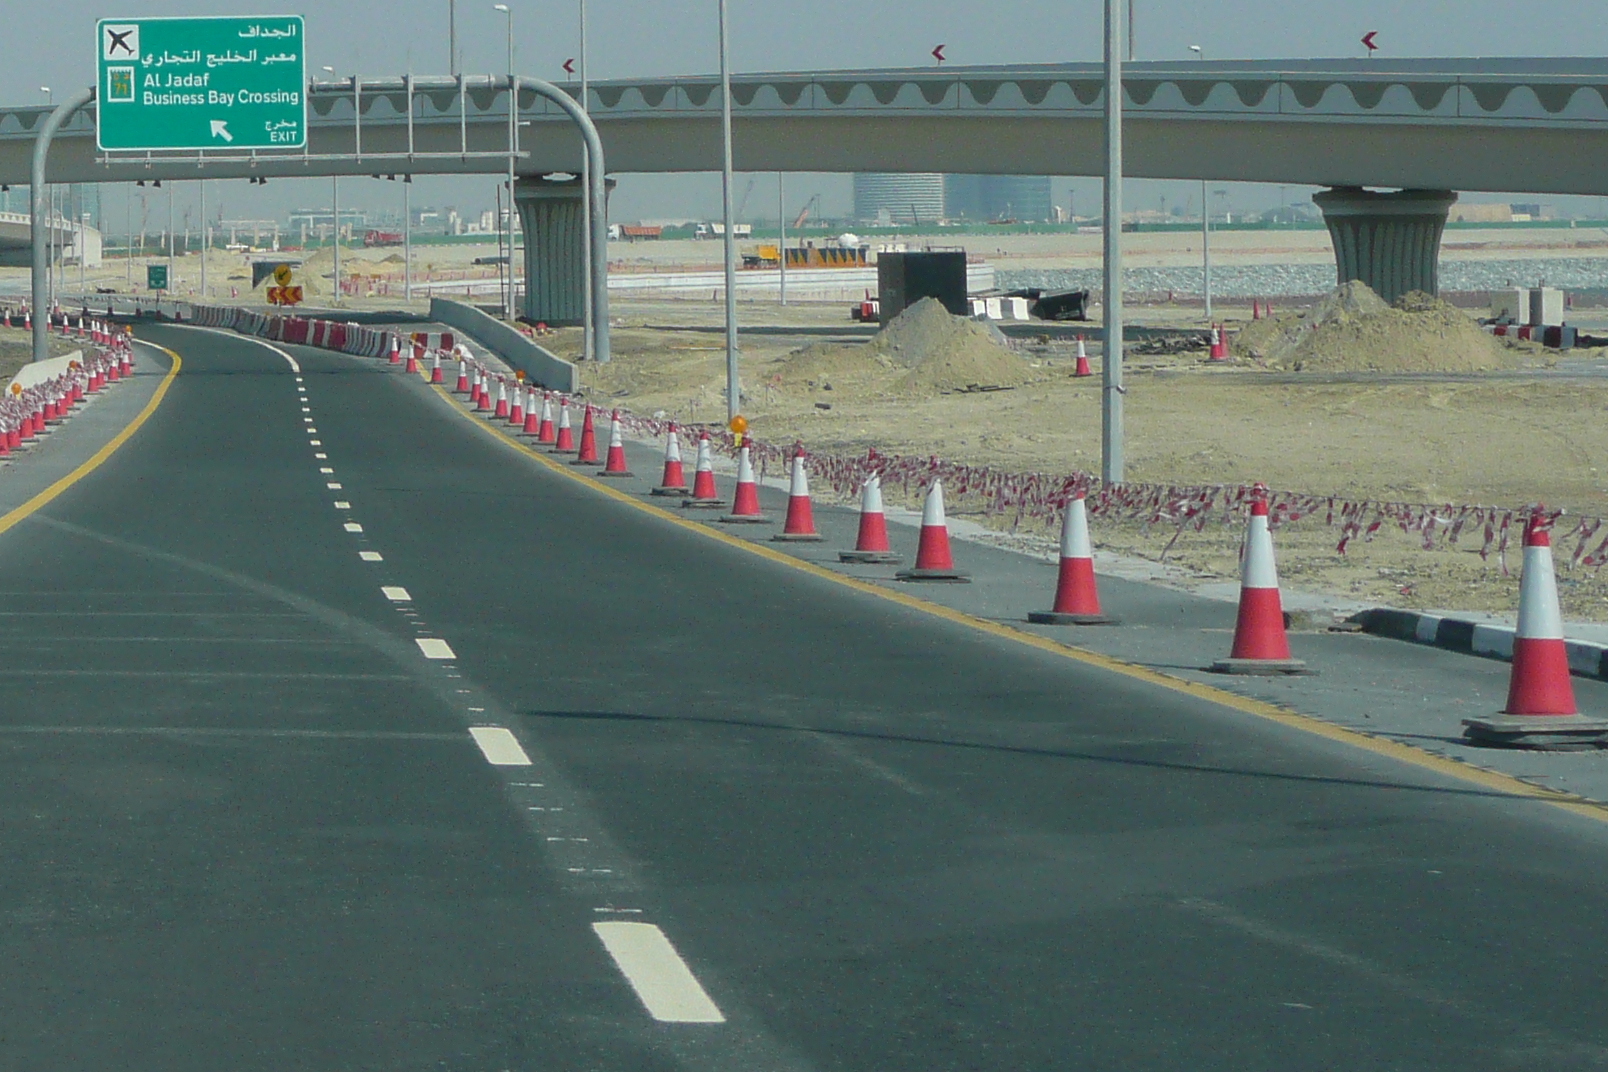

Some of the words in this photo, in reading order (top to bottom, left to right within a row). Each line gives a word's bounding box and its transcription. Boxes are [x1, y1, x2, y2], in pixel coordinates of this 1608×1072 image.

[238, 24, 296, 40] الجداف
[141, 50, 201, 67] التجاري
[206, 49, 257, 67] الخليج
[261, 52, 297, 65] معبر
[143, 73, 161, 87] Al
[165, 72, 210, 87] Jadaf
[143, 91, 205, 105] Business
[208, 90, 235, 107] Bay
[238, 89, 299, 106] Crossing
[264, 118, 297, 131] مخرج
[270, 131, 298, 142] EXIT
